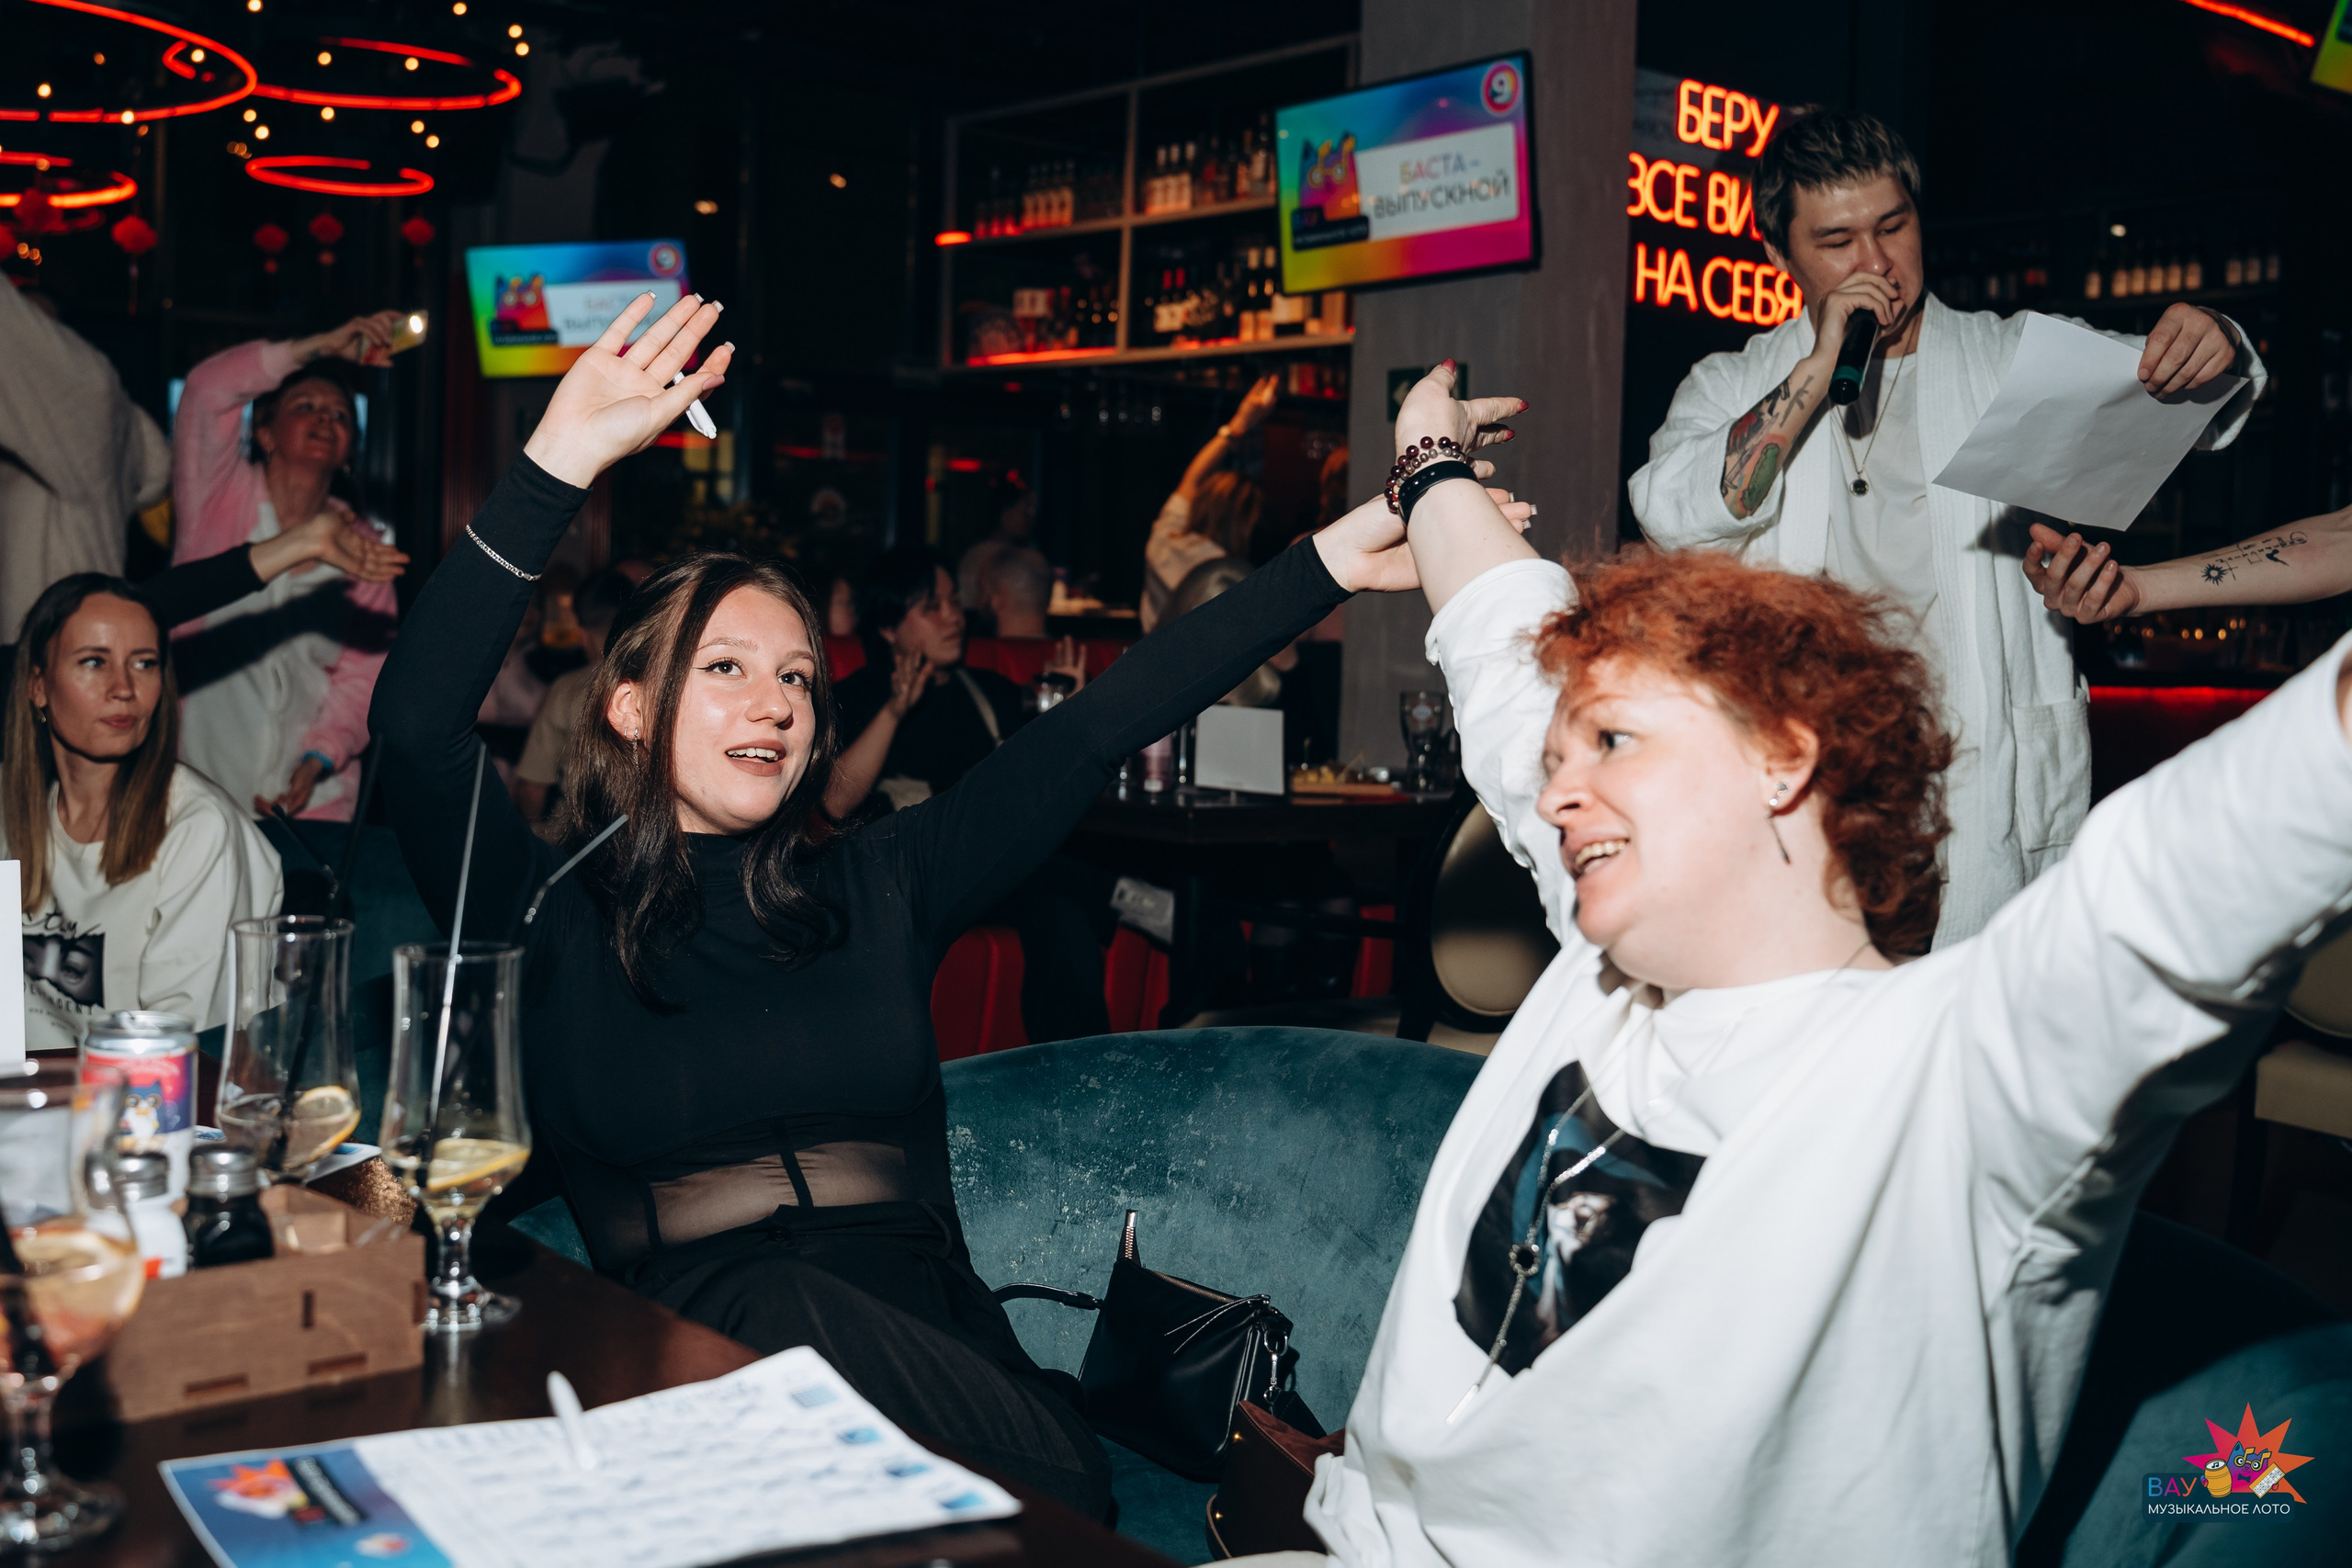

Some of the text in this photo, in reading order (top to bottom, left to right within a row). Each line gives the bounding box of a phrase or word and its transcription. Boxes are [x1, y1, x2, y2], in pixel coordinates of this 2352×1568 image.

[1490, 71, 1513, 104] 9
[1677, 78, 1780, 157] БЕРУ
[1373, 168, 1510, 220] ВЫПУСКНОЙ
[1399, 152, 1466, 184] БАСТА
[1706, 171, 1763, 241] ВИ
[1634, 242, 1803, 327] НА СЕБЯ
